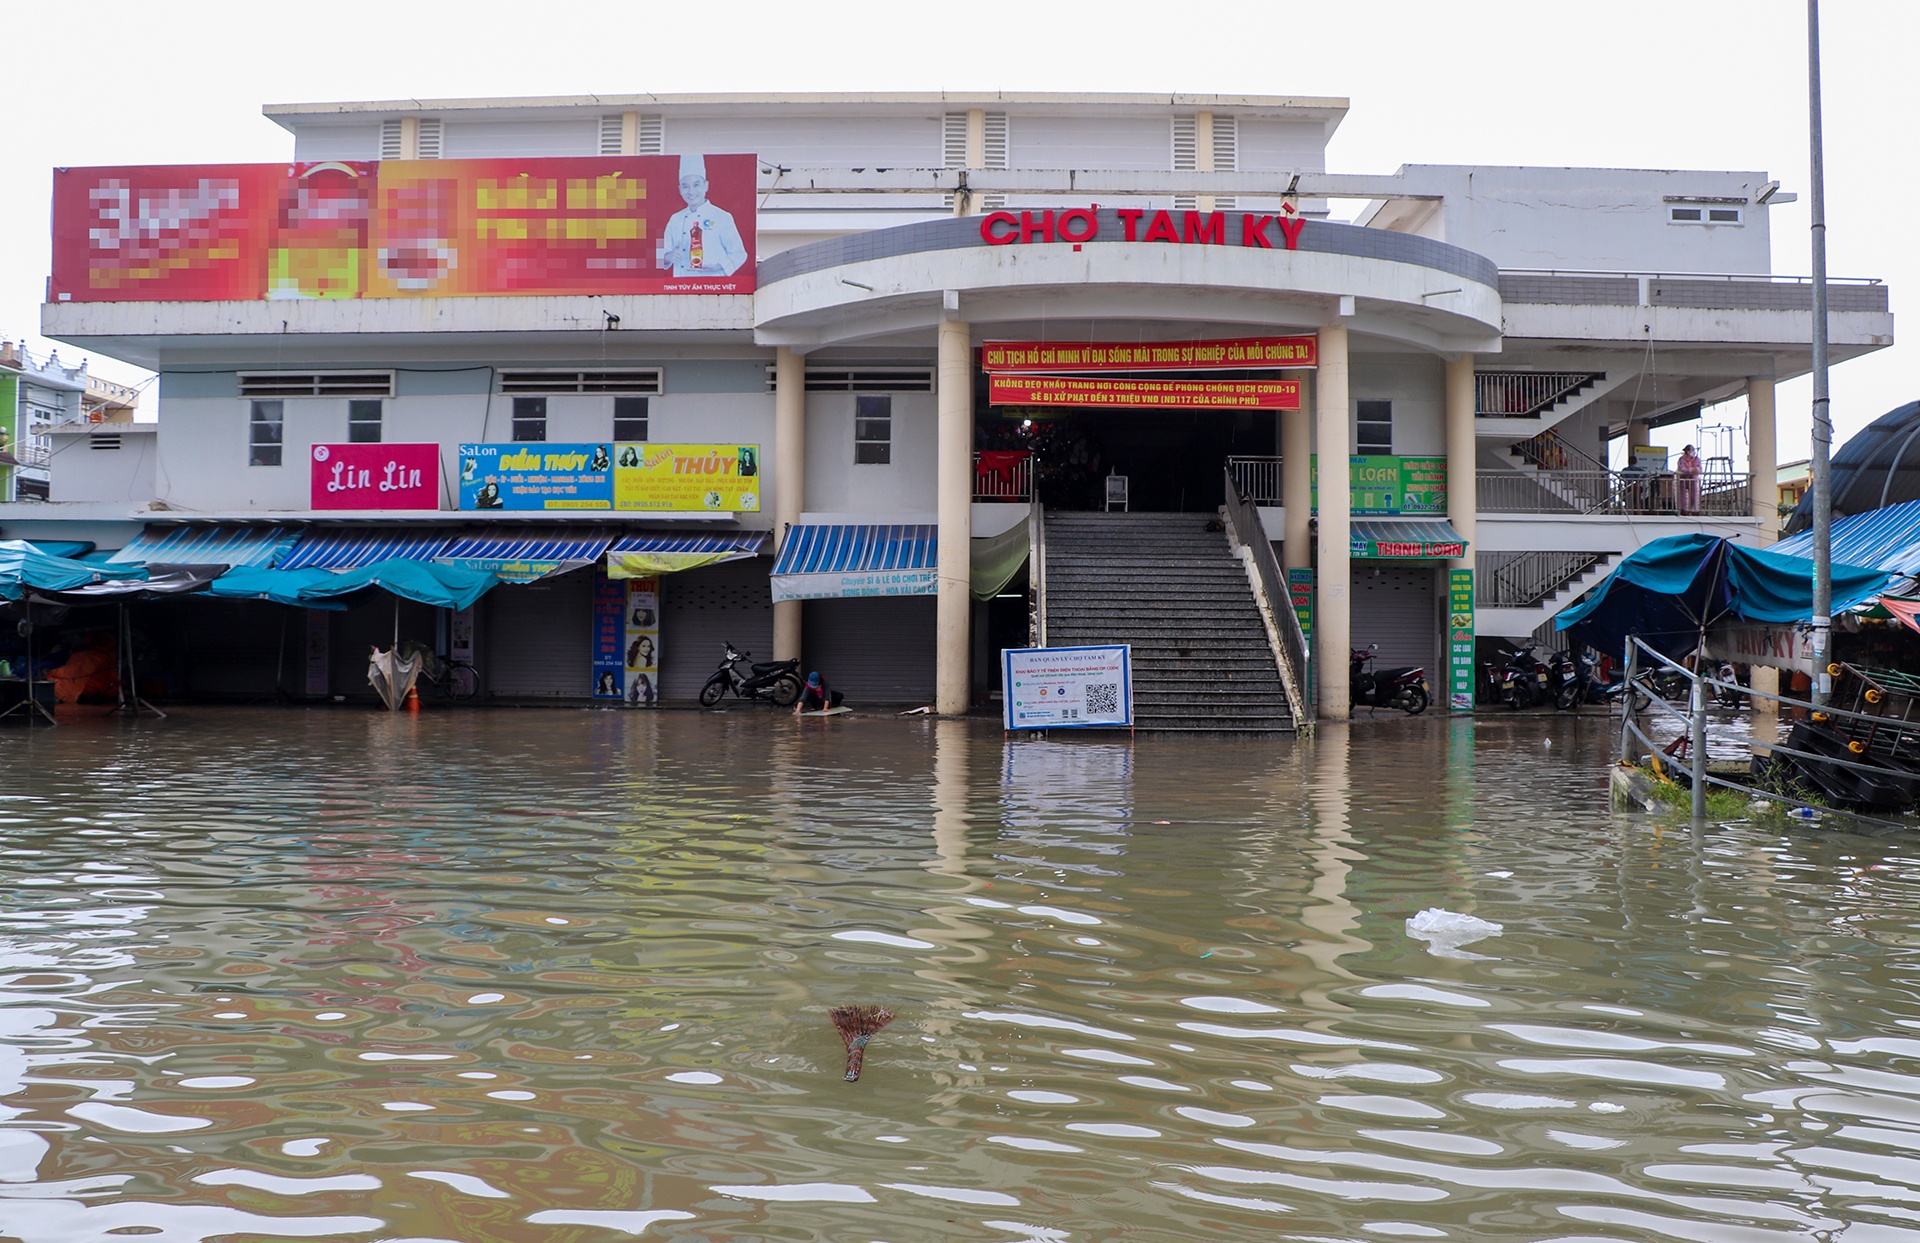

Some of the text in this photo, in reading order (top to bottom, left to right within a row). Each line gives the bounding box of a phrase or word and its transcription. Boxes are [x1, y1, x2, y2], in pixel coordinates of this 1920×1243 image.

[980, 201, 1306, 252] CHỢ TAM KỲ
[988, 342, 1308, 367] CHỦ TỊCH HỒ CHÍ MINH VĨ ĐẠI SỐNG MÃI TRONG SỰ NGHIỆP CỦA MỖI CHÚNG TA!
[994, 378, 1023, 388] KHÔNG
[1025, 380, 1041, 388] ĐEO
[1044, 378, 1066, 388] KHẨU
[1068, 381, 1094, 390] TRANG
[1097, 382, 1112, 390] NƠI
[1138, 382, 1162, 392] CỘNG
[1206, 382, 1234, 392] CHỐNG
[1236, 385, 1256, 394] DỊCH
[1258, 384, 1296, 393] COVID-19
[1044, 393, 1052, 402] BỊ
[1054, 391, 1066, 401] XỬ
[1068, 393, 1089, 402] PHẠT
[1090, 392, 1107, 402] ĐẾN
[1109, 394, 1114, 402] 3
[1116, 394, 1140, 404] TRIỆU
[1193, 394, 1210, 404] CỦA
[1212, 395, 1238, 404] CHÍNH
[1239, 394, 1260, 406] PHỦ)
[460, 446, 497, 456] SaLon
[544, 450, 589, 470] THÚY
[644, 448, 674, 470] Salon
[672, 450, 737, 475] THỦY
[1404, 461, 1419, 470] BÁN
[1421, 461, 1434, 470] CÁC
[327, 461, 422, 492] Lin Lin
[1360, 468, 1397, 482] LOAN
[1352, 542, 1463, 557] MAY THANH LOAN
[876, 576, 880, 584] &
[902, 574, 918, 583] CHƠI
[920, 572, 931, 582] TRẺ
[886, 586, 898, 595] HOA
[901, 584, 911, 594] VẢI
[913, 585, 926, 594] CAO
[1290, 584, 1312, 593] THANH
[1292, 596, 1309, 606] LOAN
